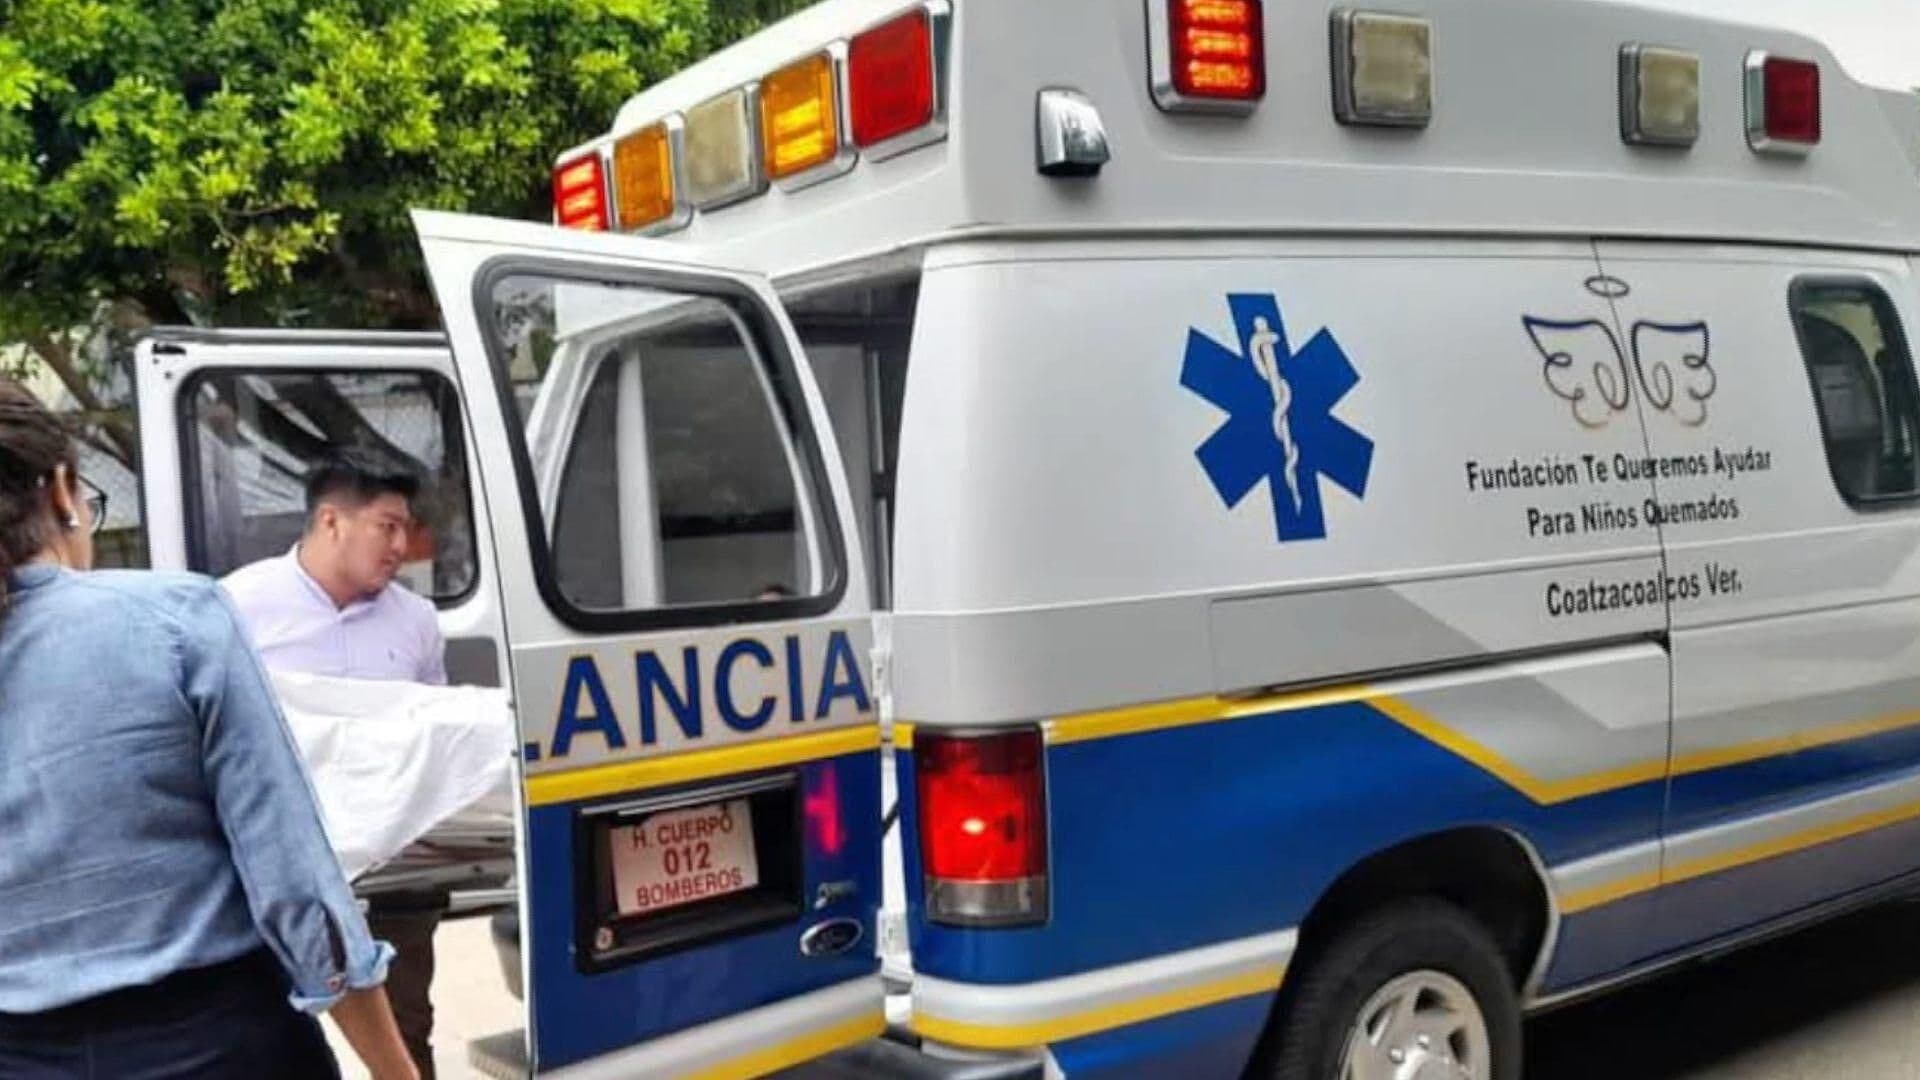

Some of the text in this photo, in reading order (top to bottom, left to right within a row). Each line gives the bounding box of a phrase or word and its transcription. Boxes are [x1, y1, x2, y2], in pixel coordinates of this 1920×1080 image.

[1466, 447, 1771, 491] Fundación Te Queremos Ayudar
[1527, 494, 1738, 536] Para Niños Quemados
[1546, 563, 1742, 616] Coatzacoalcos Ver.
[525, 630, 872, 762] ANCIA
[657, 812, 733, 845] CUERPO
[663, 842, 711, 875] 012
[637, 867, 743, 907] BOMBEROS
